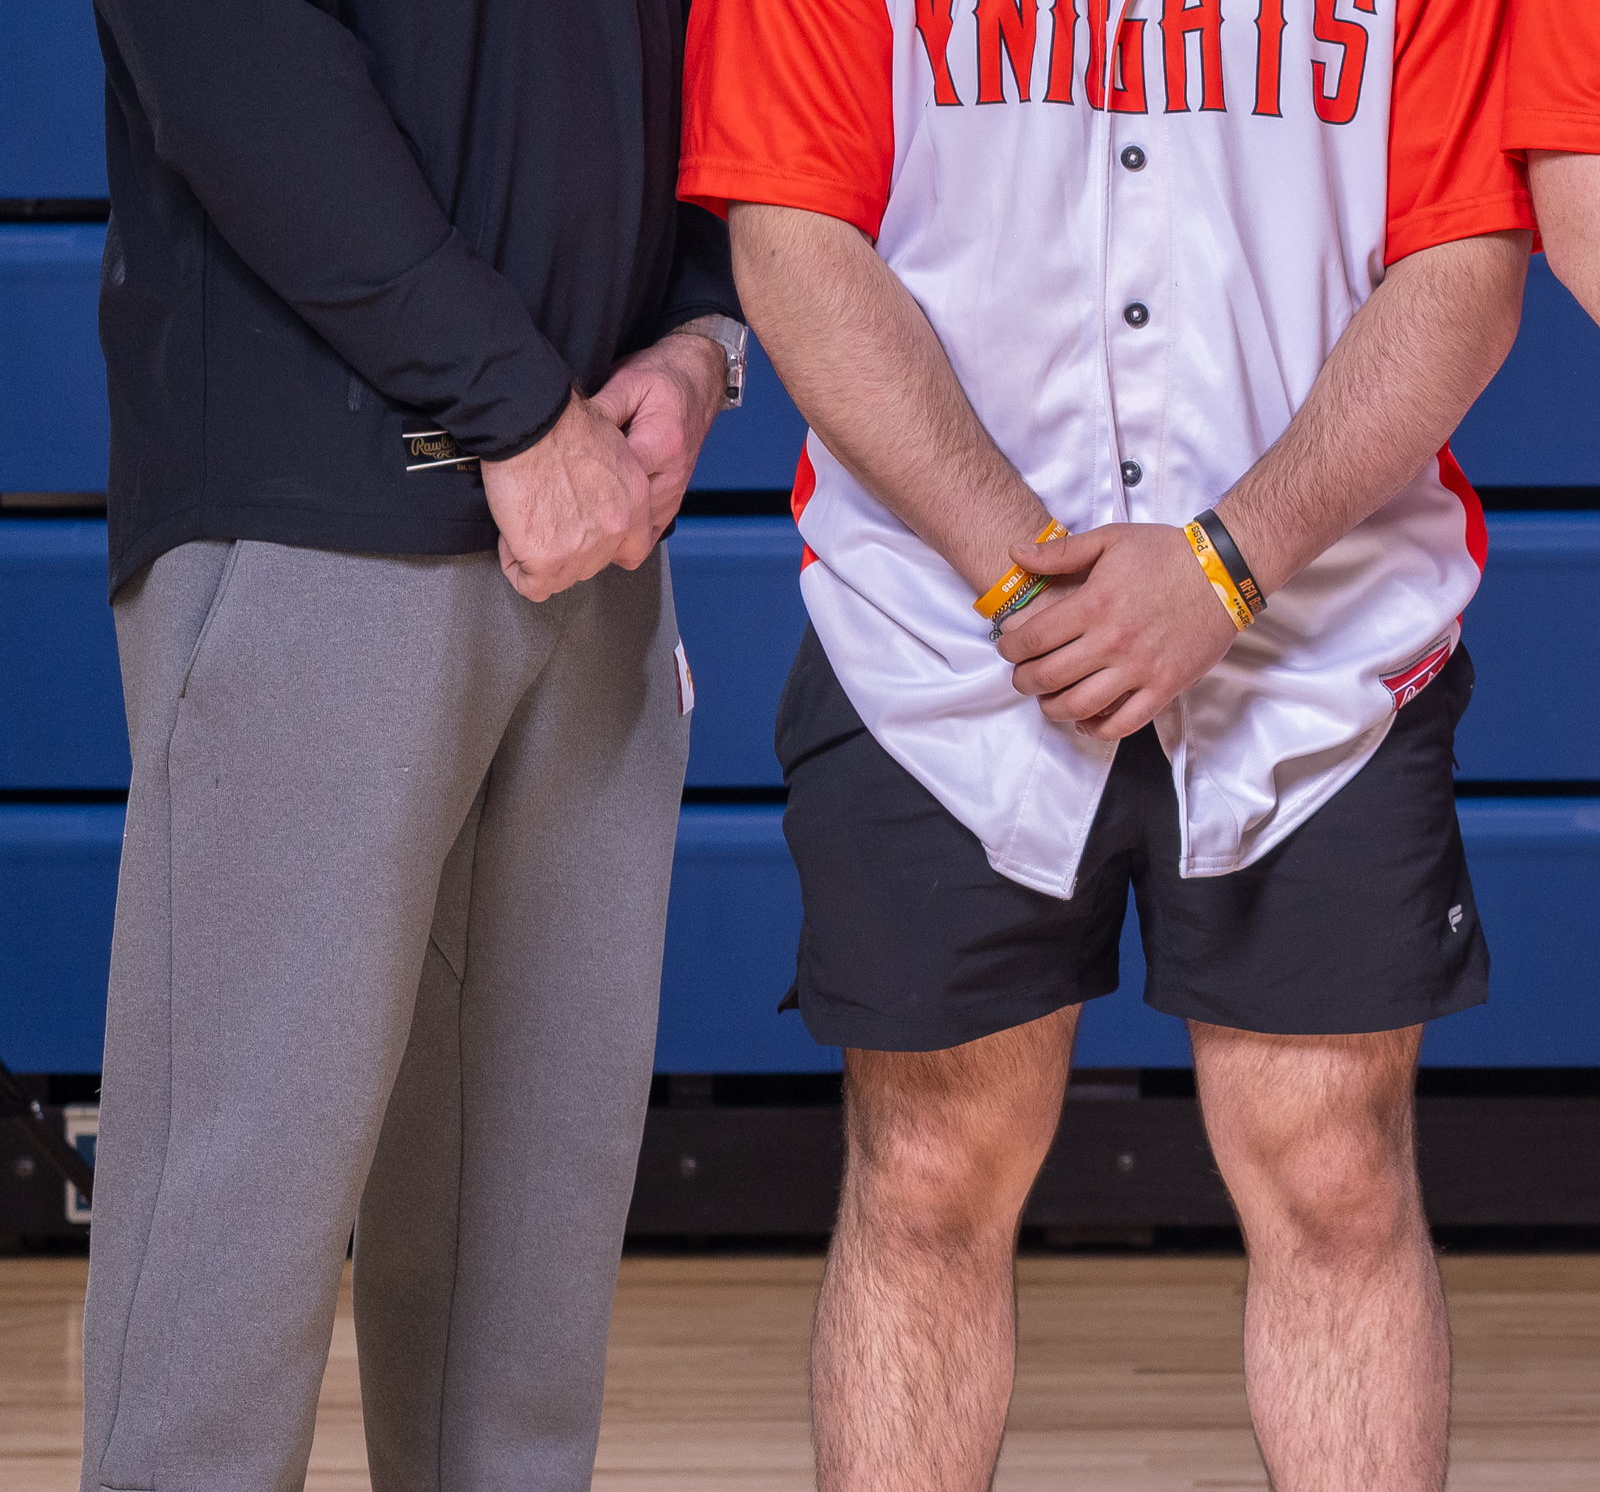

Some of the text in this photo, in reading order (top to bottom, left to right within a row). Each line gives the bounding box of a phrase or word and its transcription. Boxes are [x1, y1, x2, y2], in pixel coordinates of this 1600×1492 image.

[411, 436, 456, 456] Rawli
[1192, 525, 1208, 552] Pass
[1001, 569, 1026, 593] TTERS
[1239, 578, 1258, 599] RFA
